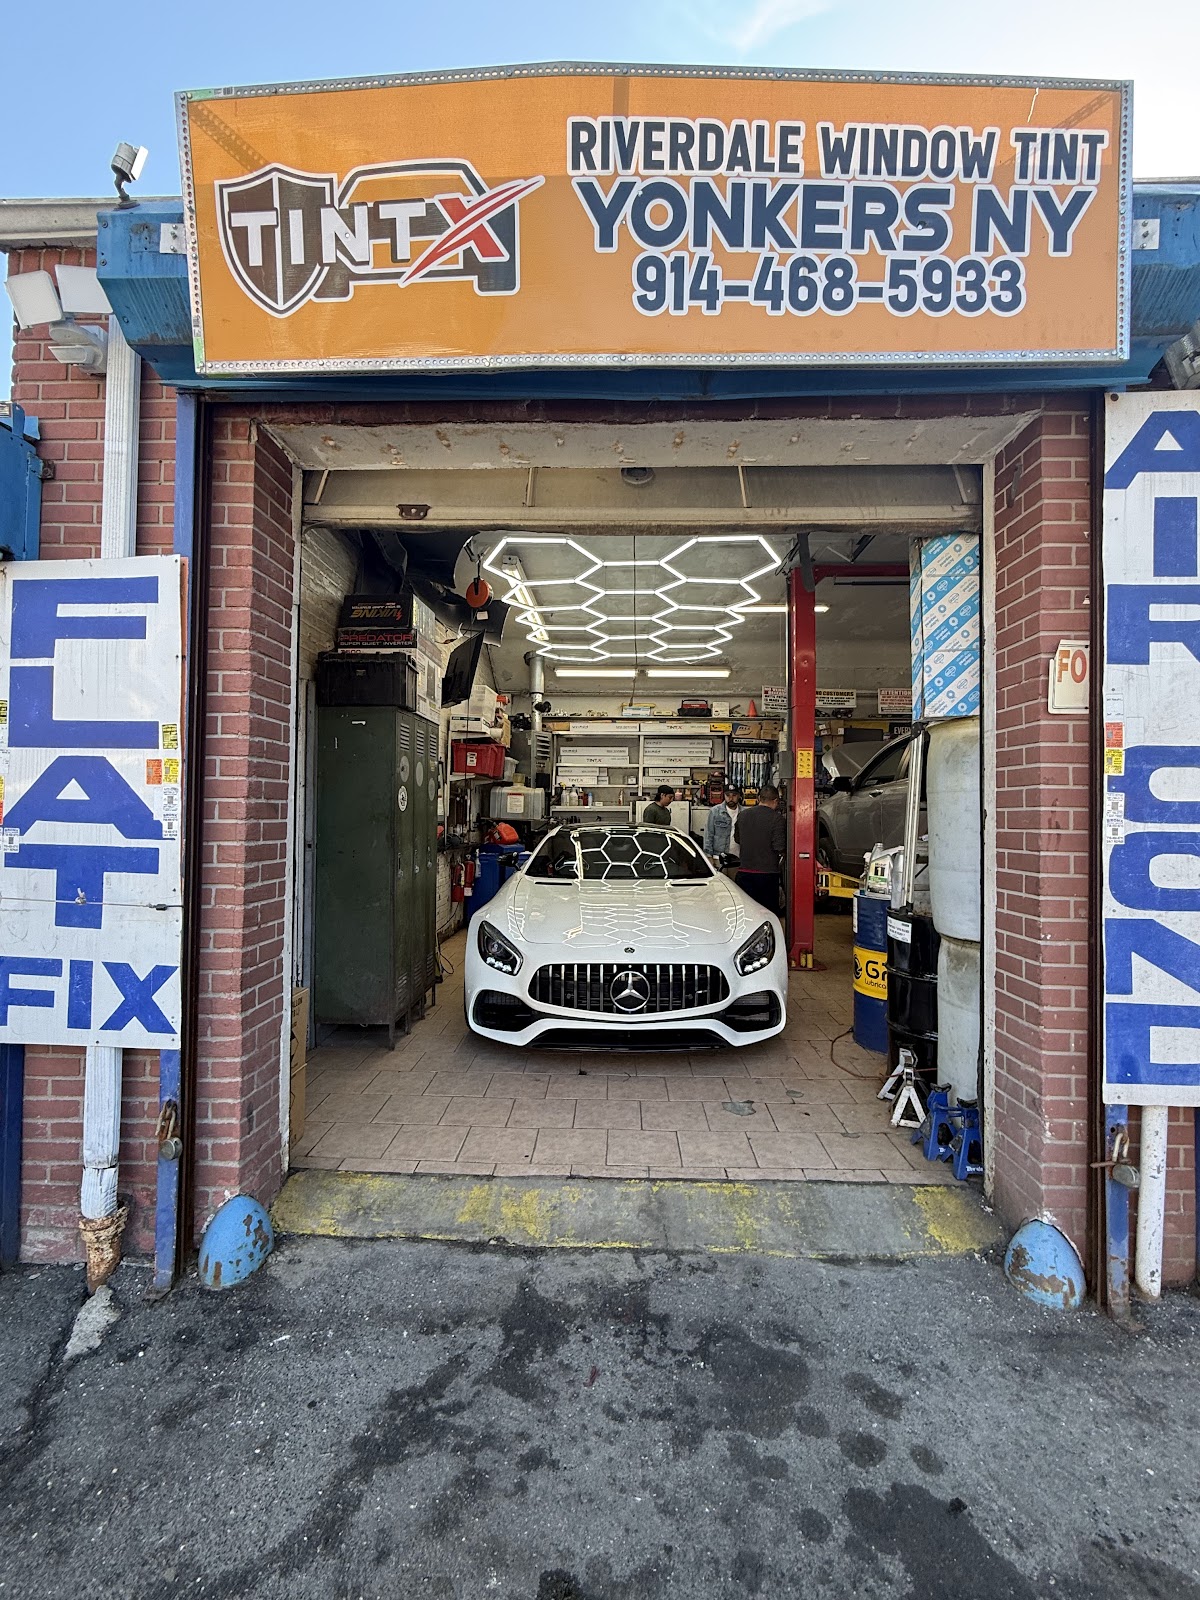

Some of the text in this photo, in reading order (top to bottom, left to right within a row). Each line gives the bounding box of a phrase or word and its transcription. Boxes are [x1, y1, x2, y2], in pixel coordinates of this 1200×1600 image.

[569, 119, 1106, 182] RIVERDALE WINDOW TINT
[574, 179, 1095, 254] YONKERS NY
[635, 253, 1024, 314] 914-468-5933
[350, 608, 399, 618] VIKING
[1057, 649, 1087, 683] FO
[0, 575, 175, 930] FLAT
[0, 956, 178, 1034] FIX
